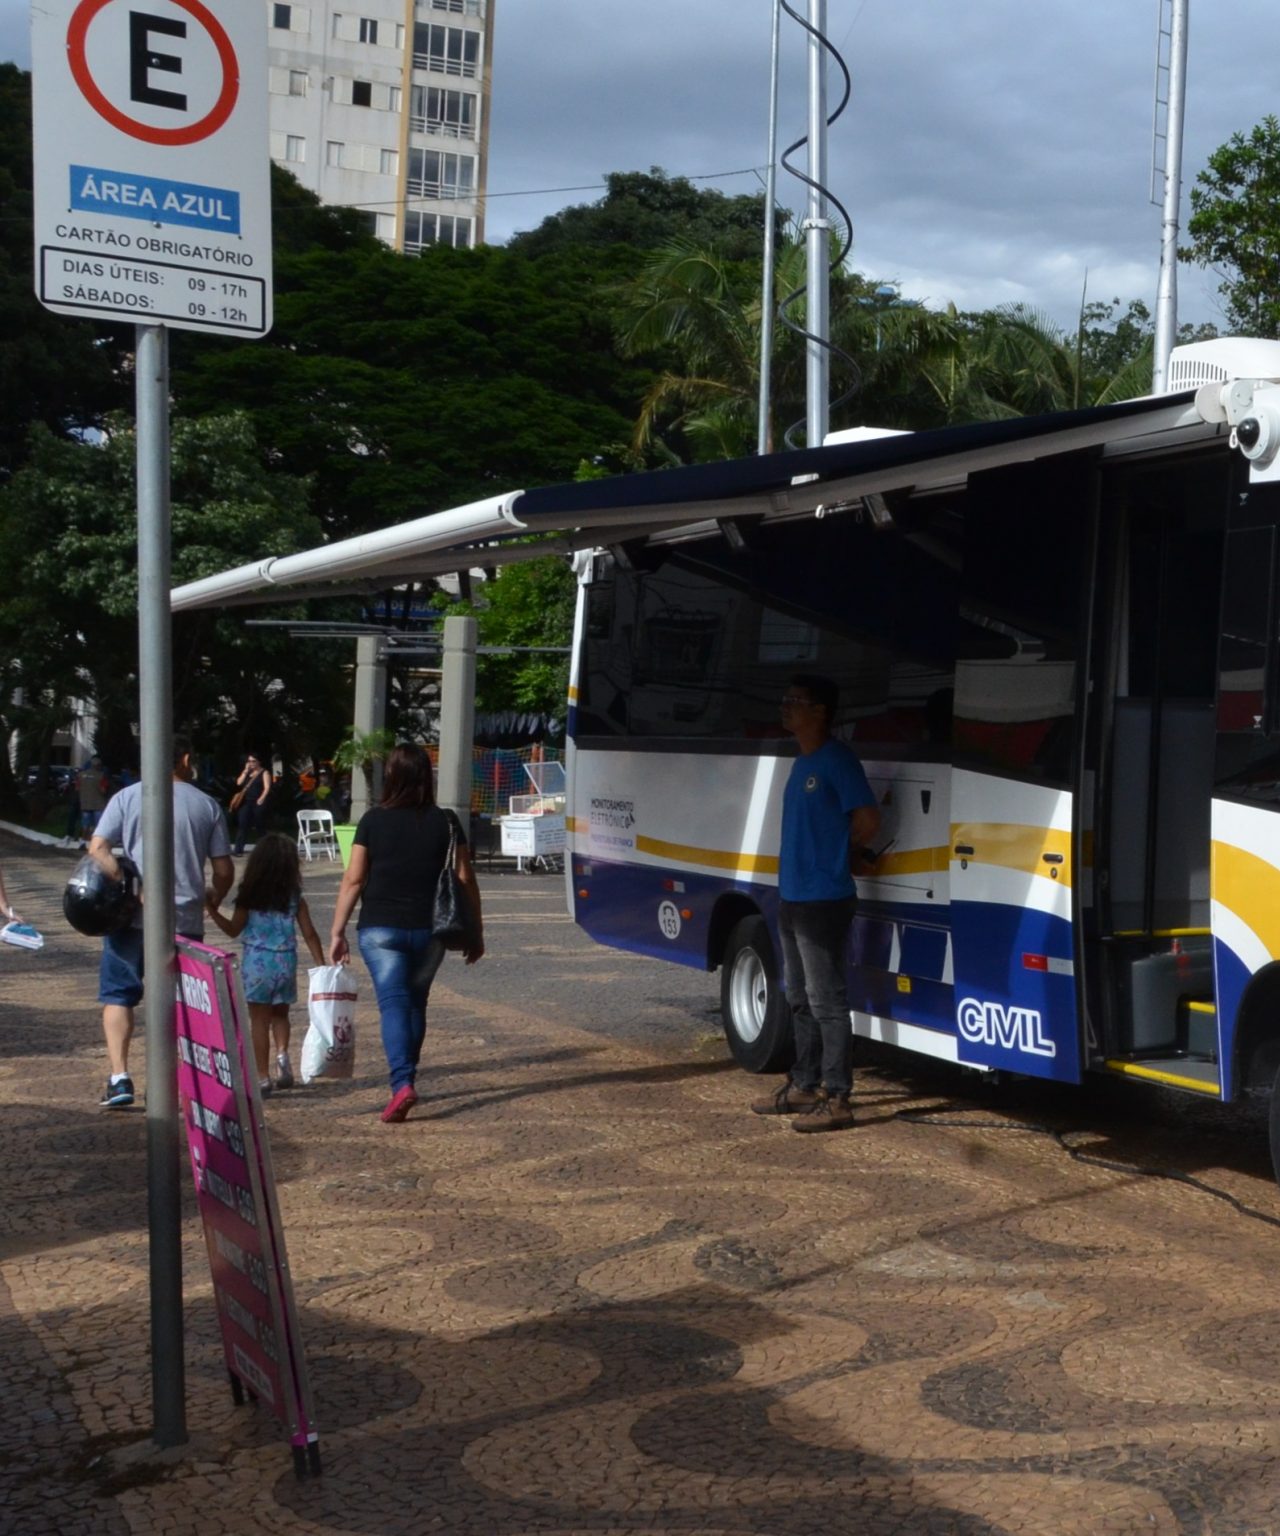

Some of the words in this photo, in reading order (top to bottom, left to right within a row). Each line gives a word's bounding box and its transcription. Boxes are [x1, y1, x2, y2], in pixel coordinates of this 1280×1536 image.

[129, 10, 187, 112] E
[80, 173, 157, 209] ÁREA
[163, 184, 232, 221] AZUL
[55, 223, 132, 249] CARTÃO
[136, 236, 254, 267] OBRIGATÓRIO
[63, 259, 104, 277] DIAS
[109, 262, 165, 286] ÚTEIS:
[188, 277, 206, 292] 09
[221, 282, 248, 299] 17h
[62, 284, 155, 310] SÁBADOS:
[188, 302, 206, 317] 09
[221, 307, 248, 323] 12h
[663, 918, 678, 936] 153
[957, 997, 1056, 1058] CIVIL
